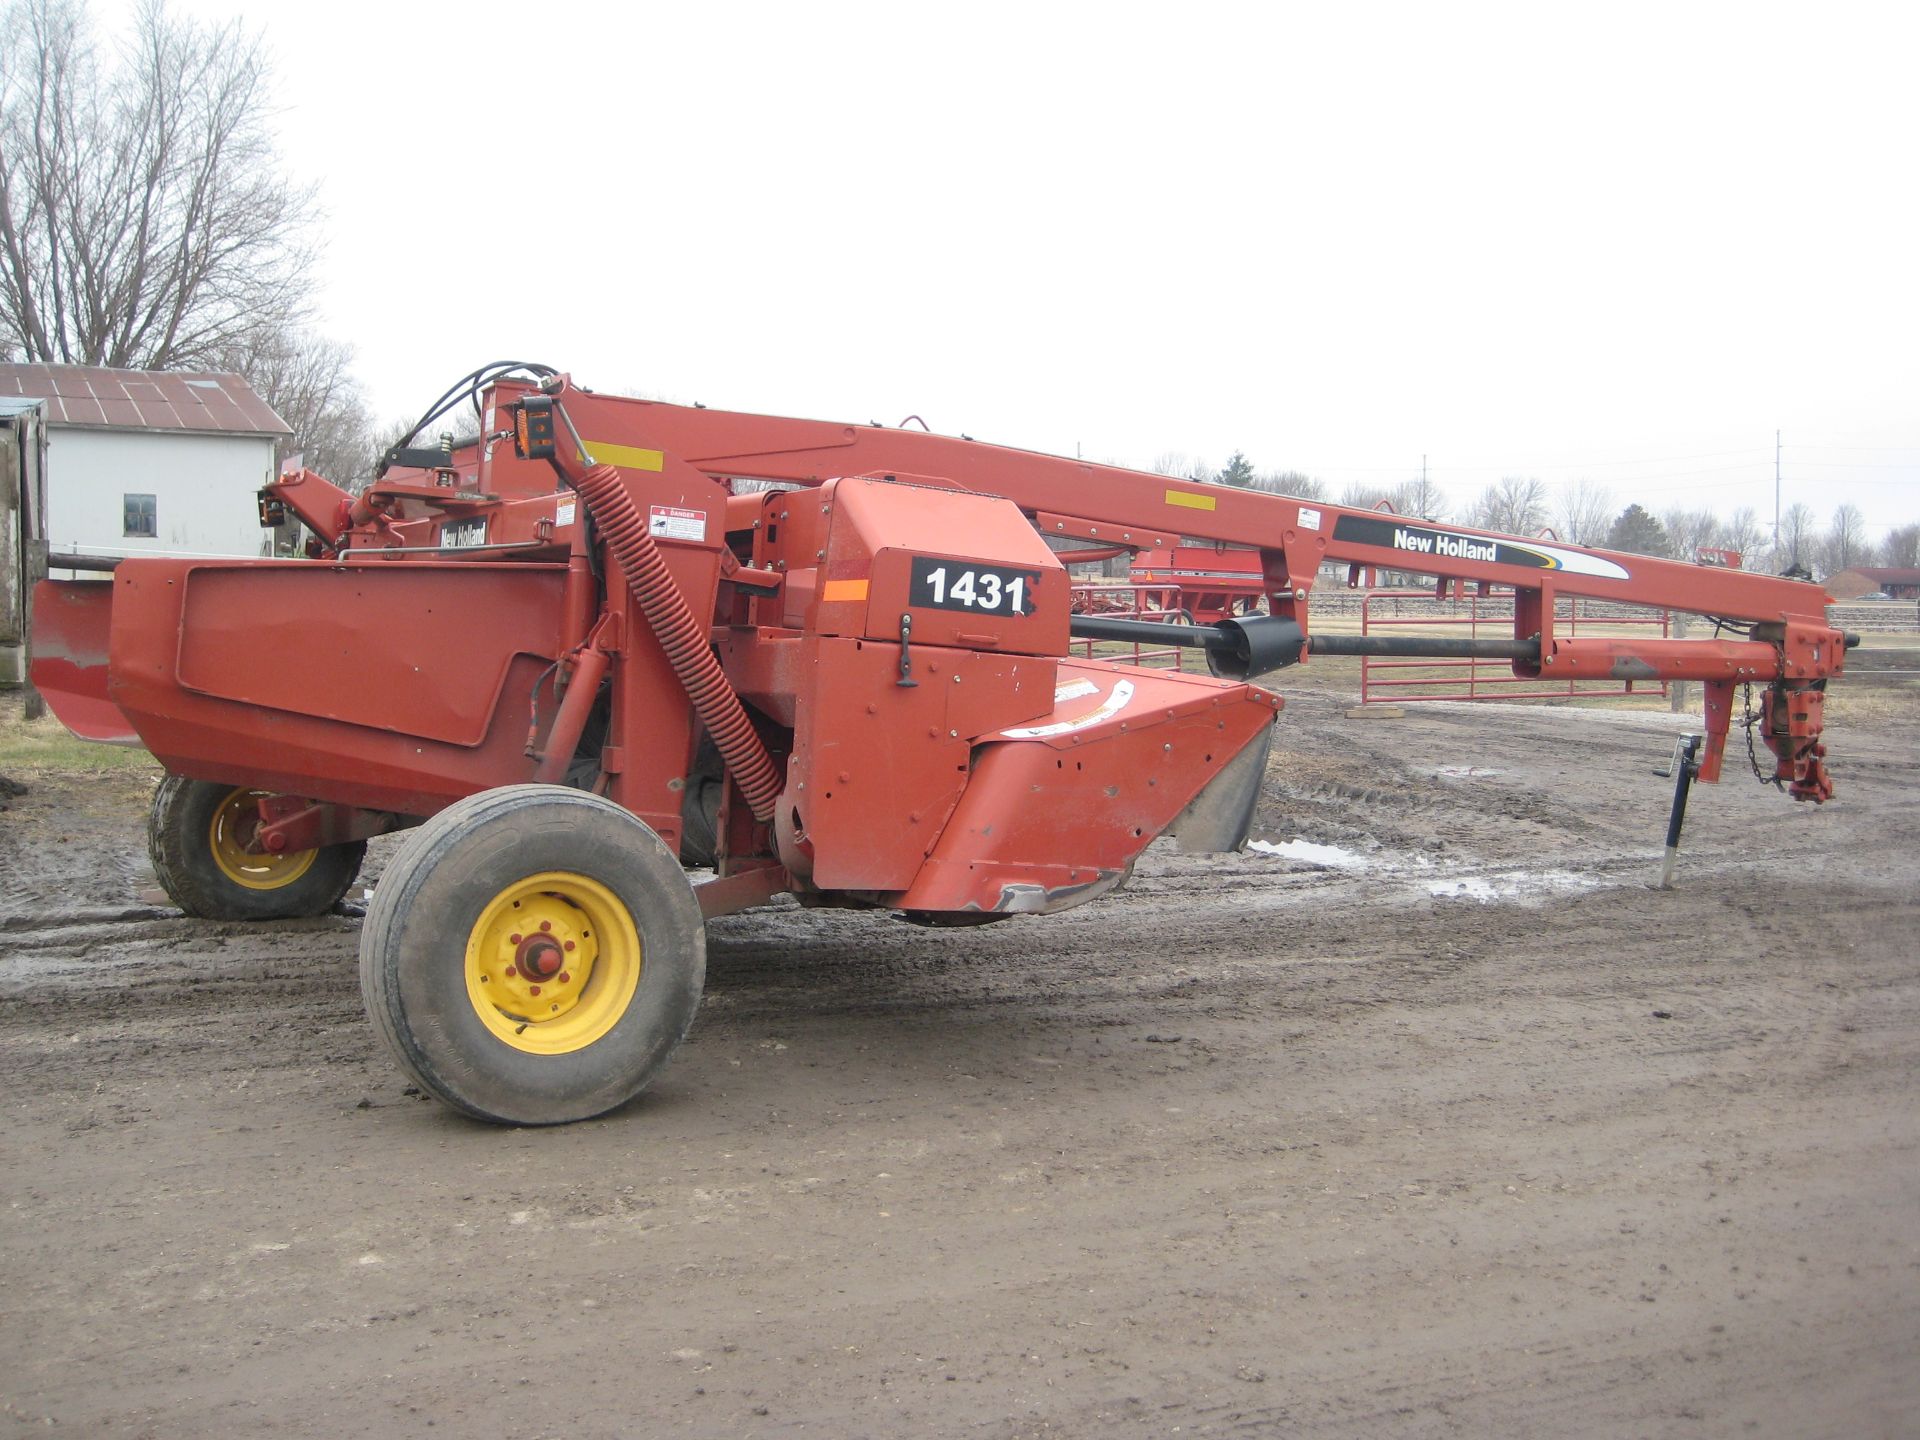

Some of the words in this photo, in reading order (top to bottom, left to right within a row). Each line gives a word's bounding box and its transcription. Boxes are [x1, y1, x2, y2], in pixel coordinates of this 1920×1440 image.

[670, 510, 695, 519] DANGER
[441, 528, 457, 548] New
[458, 521, 486, 547] Holland
[1394, 528, 1432, 553] New
[1436, 535, 1497, 562] Holland
[926, 567, 1024, 612] 1431
